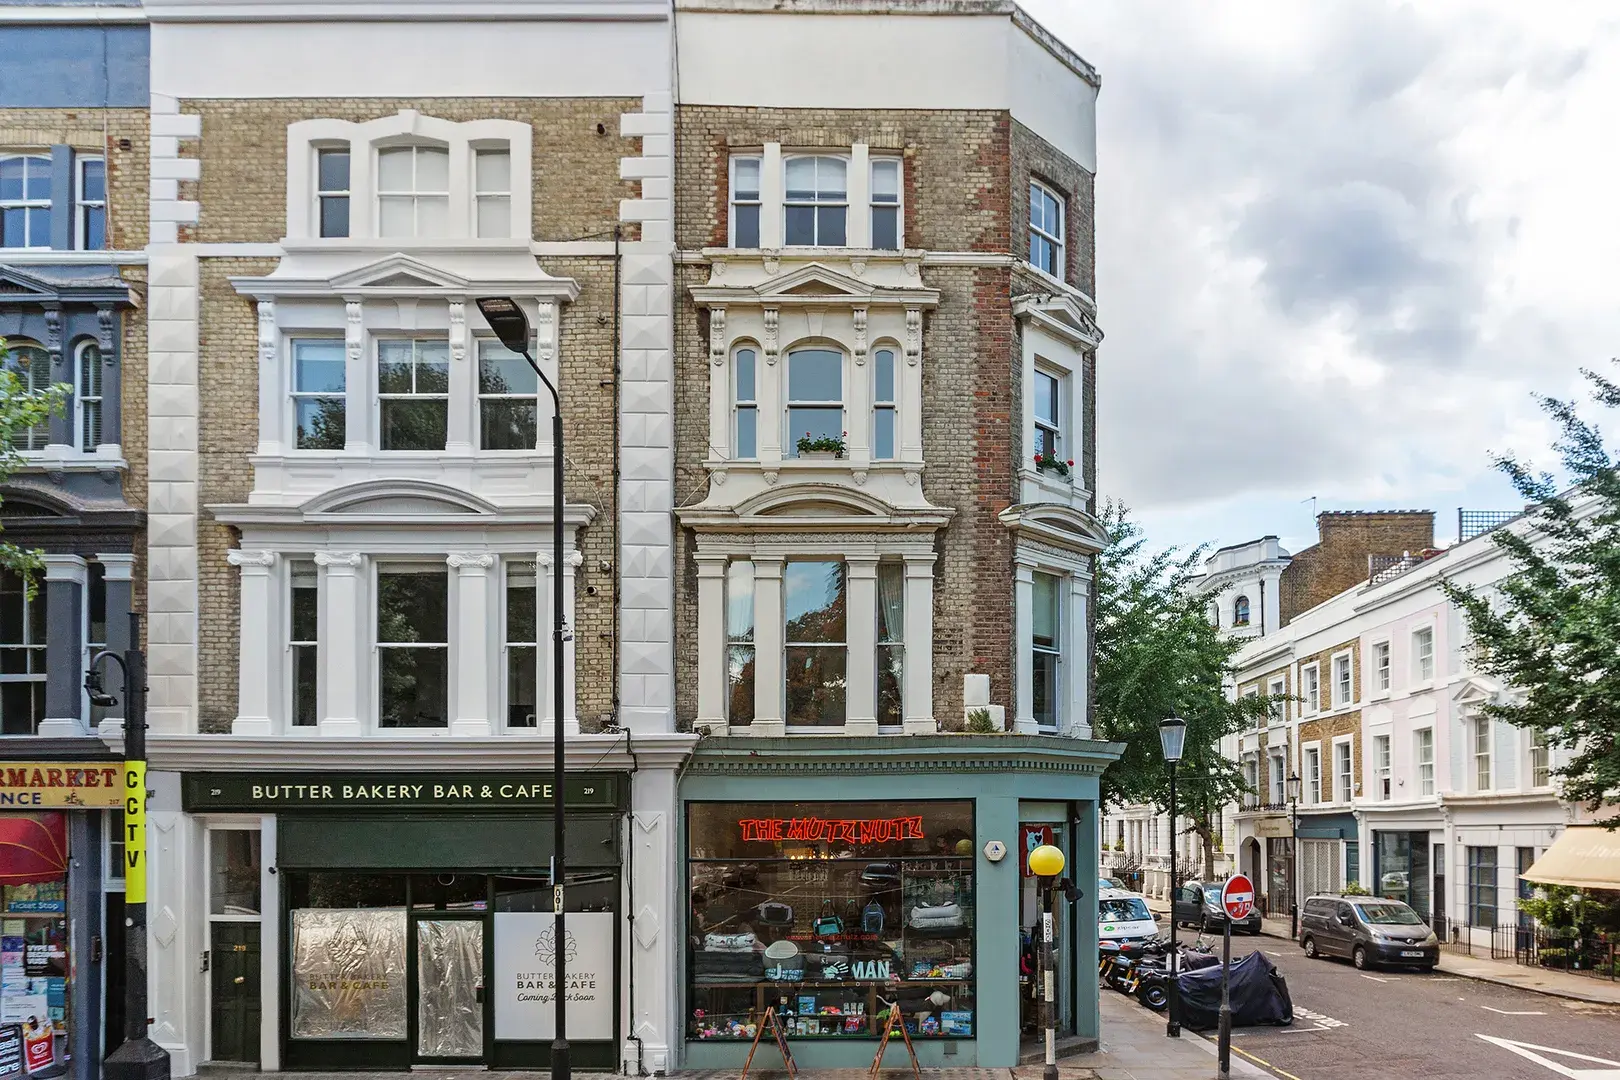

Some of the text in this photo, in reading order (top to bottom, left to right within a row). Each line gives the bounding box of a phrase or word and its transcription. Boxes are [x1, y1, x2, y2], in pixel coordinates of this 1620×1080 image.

[253, 784, 552, 799] BUTTER BAKERY BAR & CAFE
[584, 787, 594, 795] 219
[126, 771, 139, 868] CCTV
[739, 816, 924, 844] THE MUTZ NUTZ
[38, 902, 59, 910] Stop
[310, 982, 389, 990] BAR & CAFE
[517, 981, 544, 989] BAR
[548, 981, 556, 989] &
[517, 993, 549, 1004] Coming
[573, 993, 596, 1002] Soon
